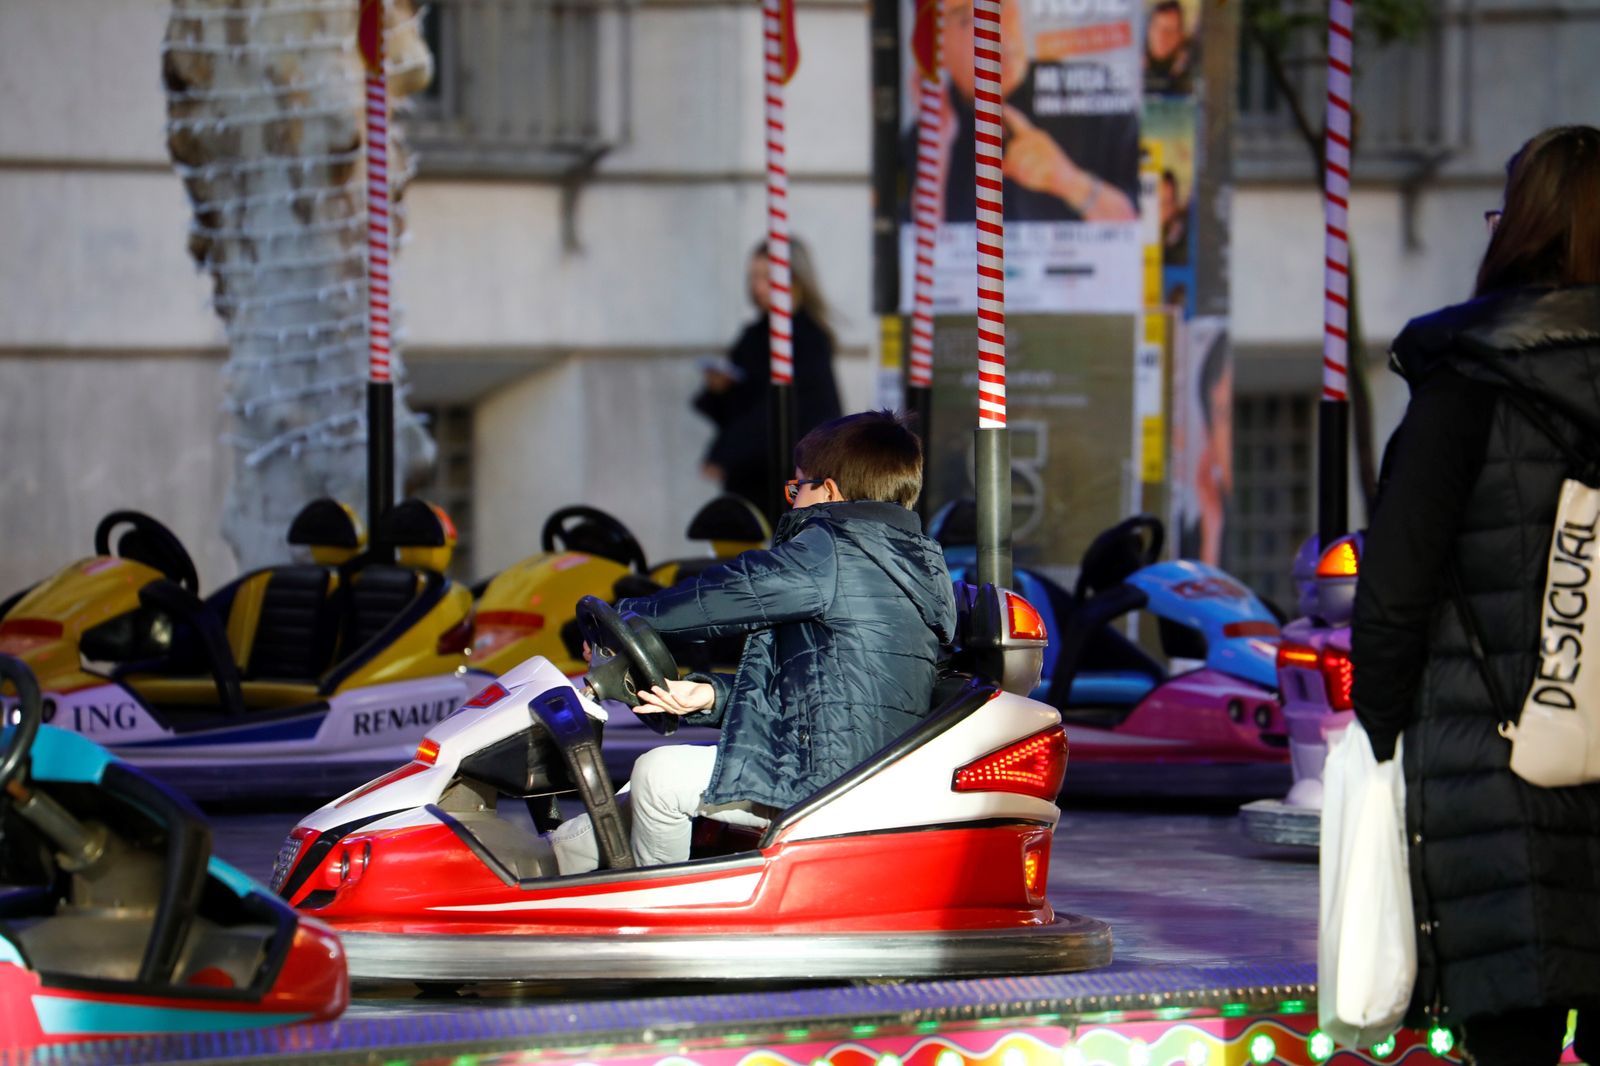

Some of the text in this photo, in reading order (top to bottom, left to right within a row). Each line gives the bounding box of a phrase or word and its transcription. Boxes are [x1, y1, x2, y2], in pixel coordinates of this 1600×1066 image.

[1532, 511, 1600, 710] DESIGUAL
[73, 701, 136, 732] ING
[354, 697, 461, 736] RENAULT
